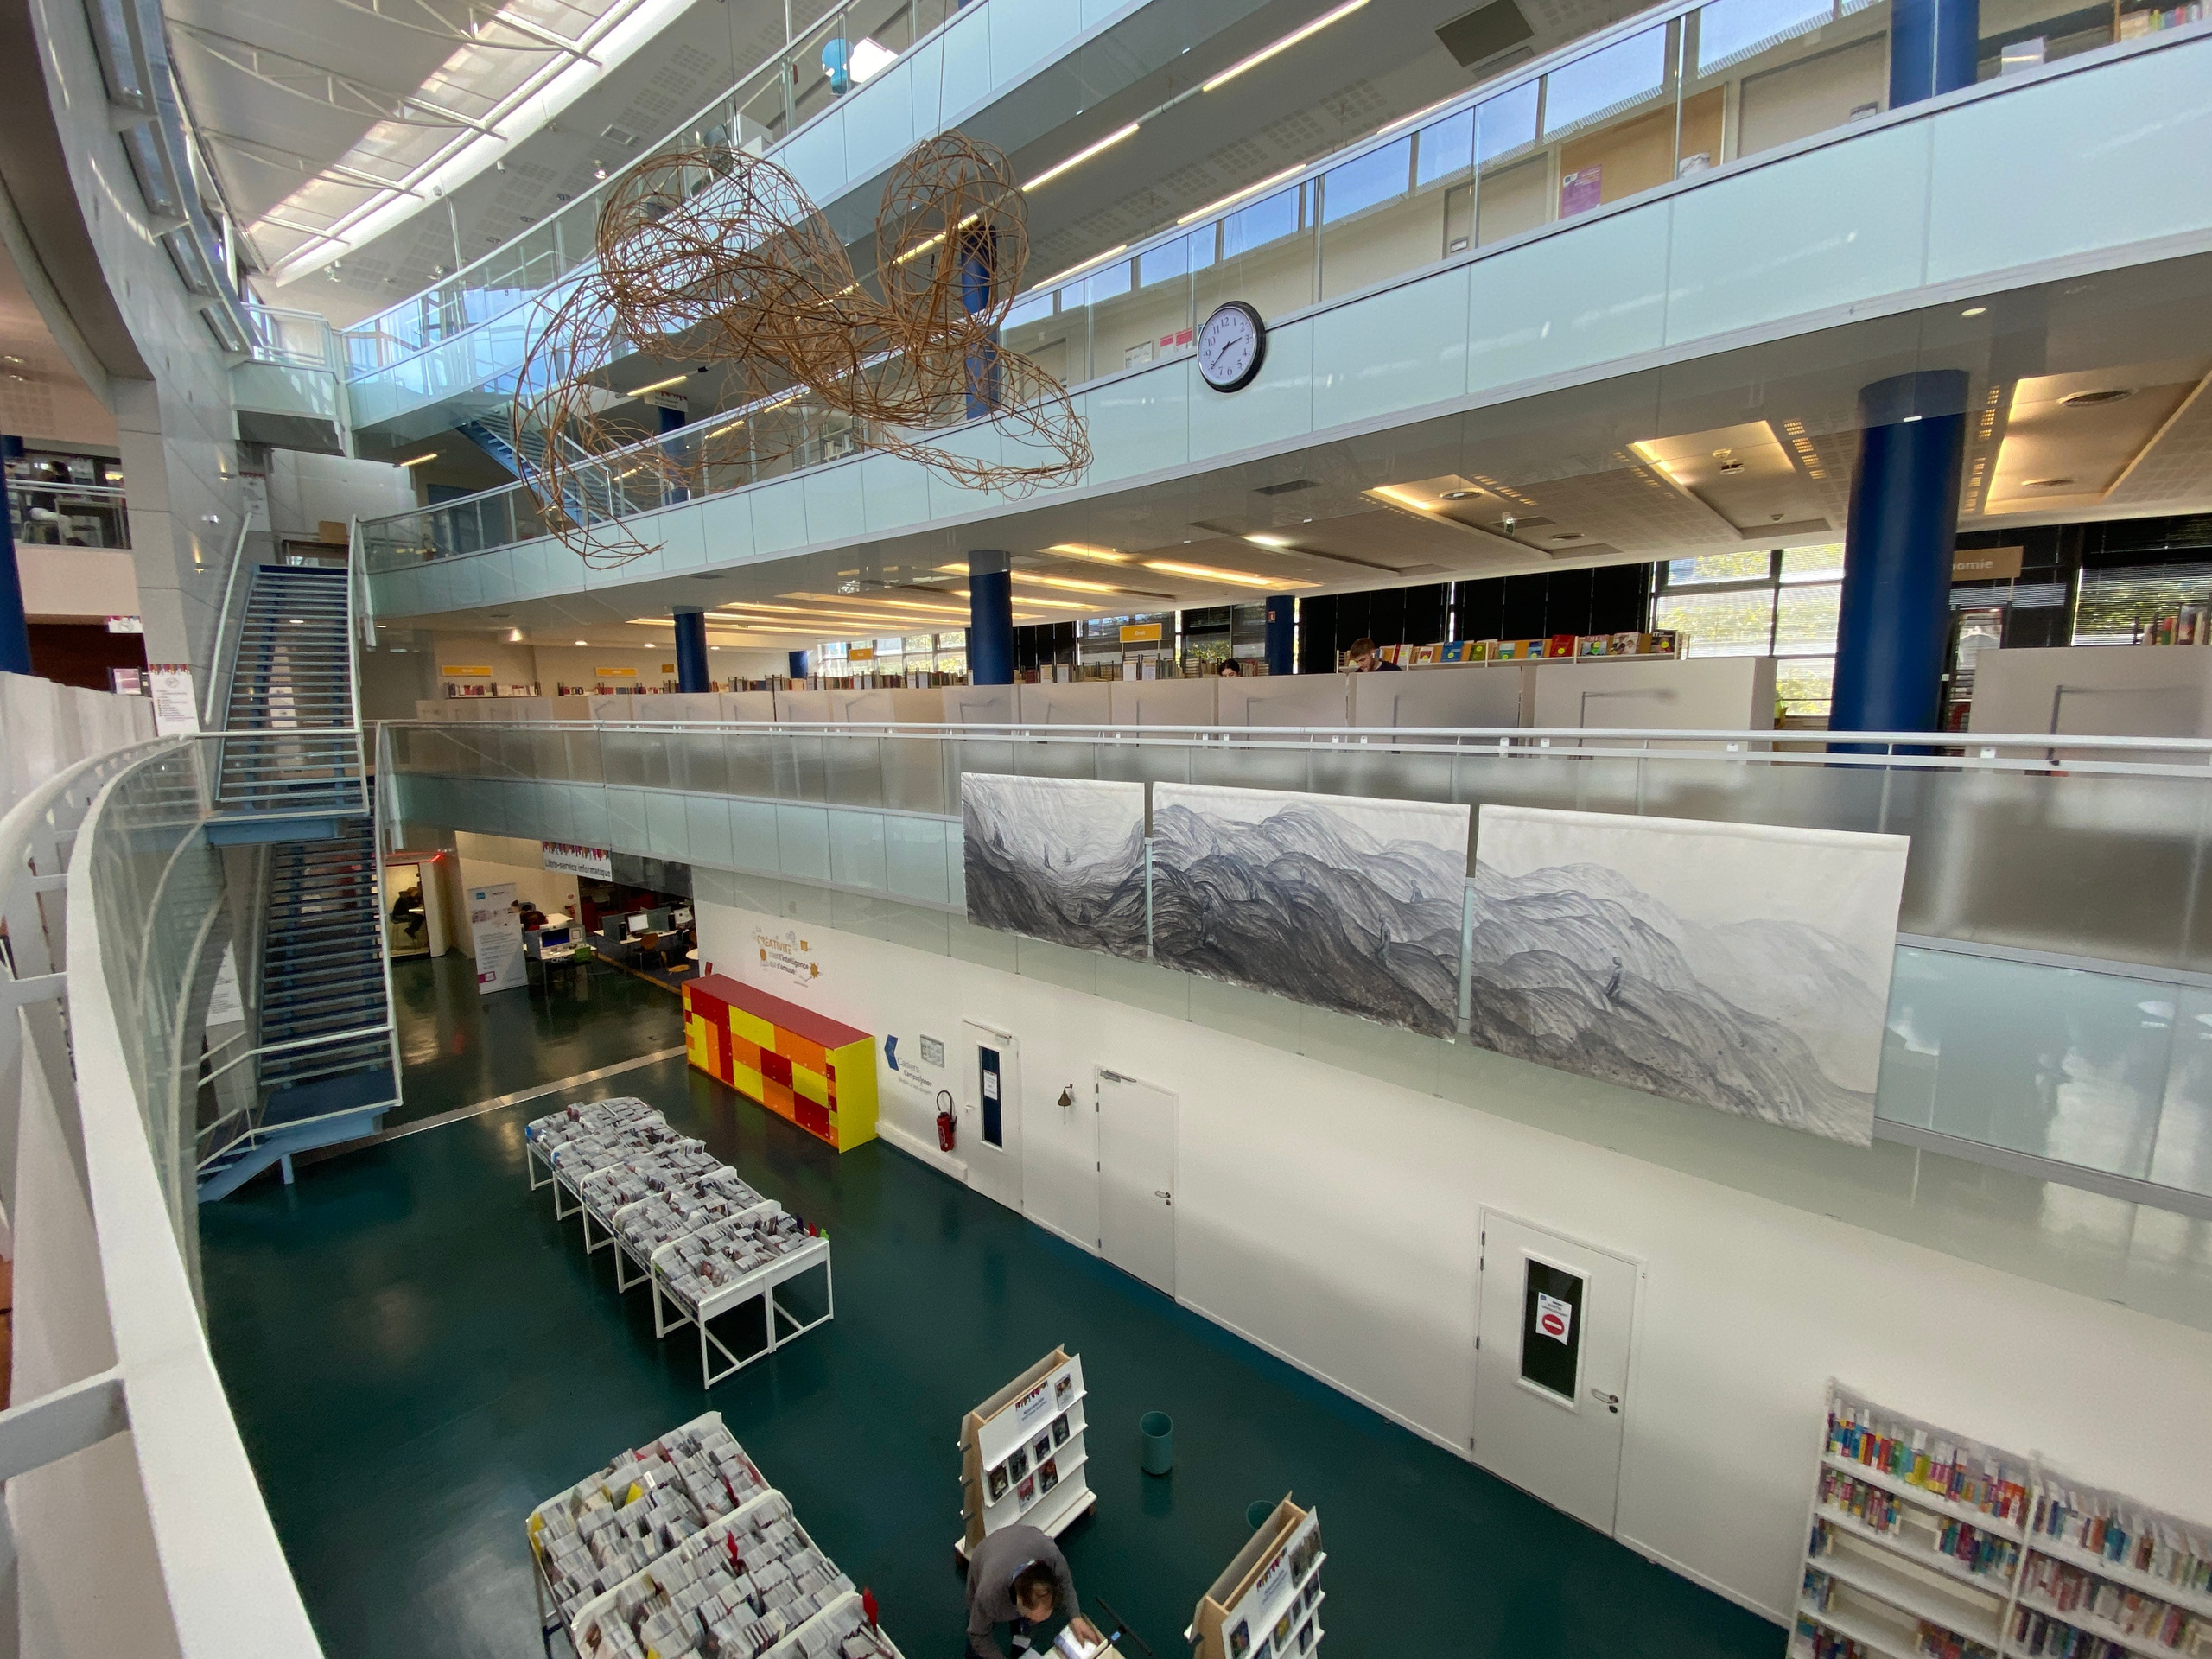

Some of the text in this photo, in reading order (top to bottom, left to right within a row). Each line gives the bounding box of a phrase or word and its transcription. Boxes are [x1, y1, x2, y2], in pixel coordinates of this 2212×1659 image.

[1221, 317, 1230, 327] 12
[1233, 317, 1236, 327] 1
[1240, 322, 1245, 332] 2
[1213, 324, 1220, 335] 11
[1207, 336, 1216, 346] 10
[1244, 334, 1250, 344] 3
[1243, 347, 1248, 357] 4
[1237, 359, 1243, 370] 5
[1218, 366, 1224, 376] 7
[1227, 367, 1233, 376] 6
[545, 859, 611, 878] Libre-service informatique
